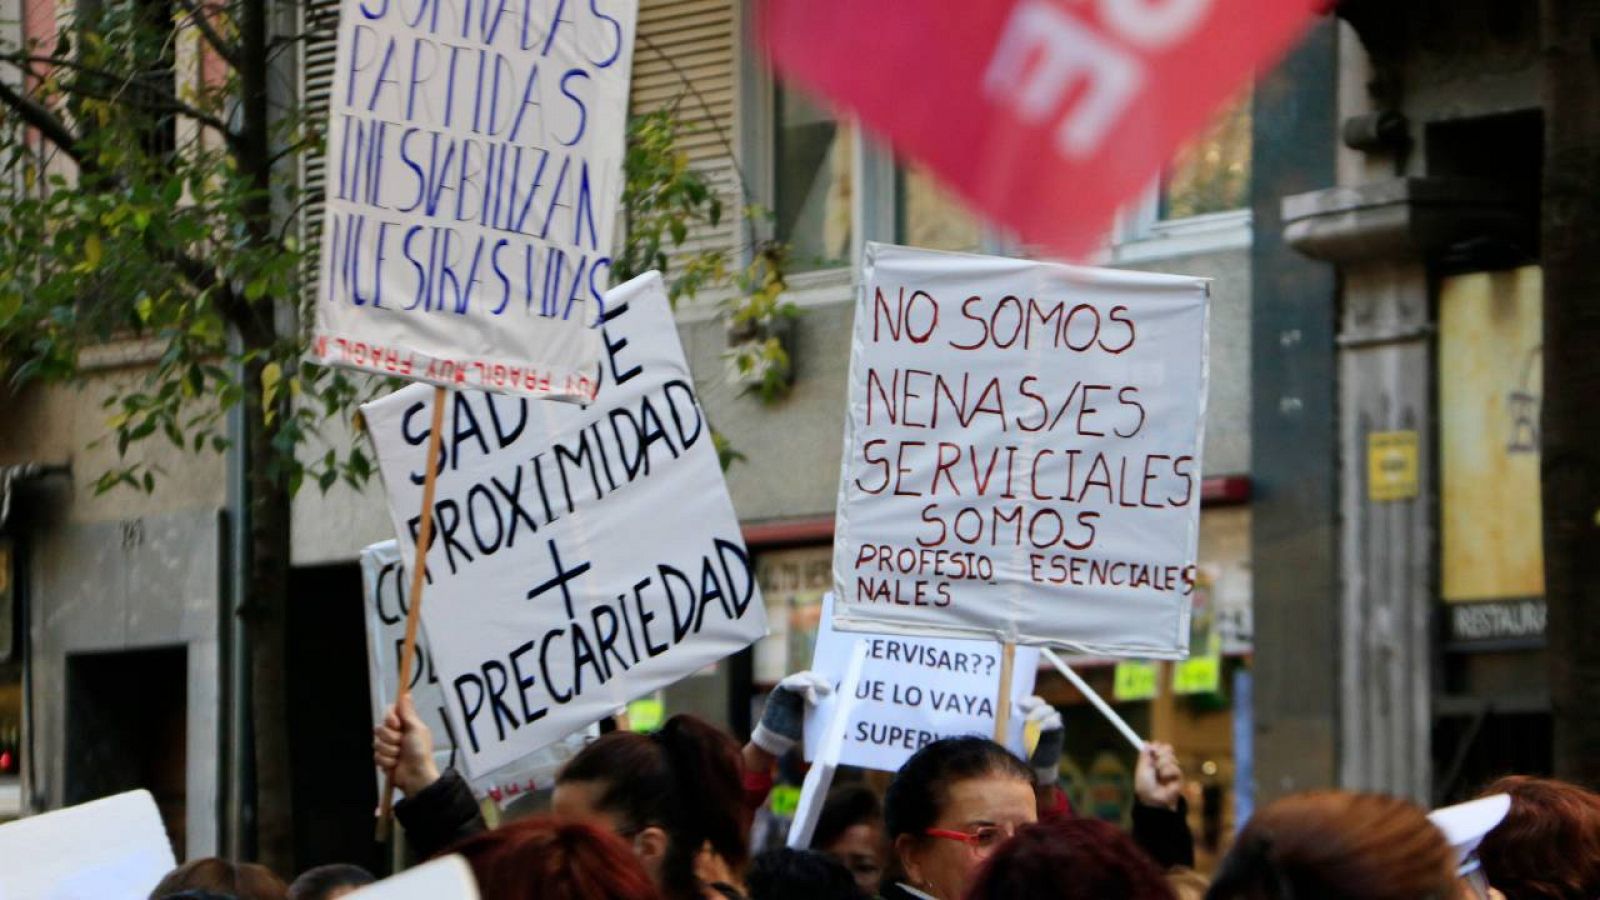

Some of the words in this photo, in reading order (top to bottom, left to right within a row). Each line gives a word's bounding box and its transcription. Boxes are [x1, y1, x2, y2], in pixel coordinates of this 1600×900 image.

[347, 24, 590, 146] PARTIDAS
[335, 113, 598, 251] INESTABILIZAN
[328, 214, 511, 315] NUESTRAS
[526, 243, 612, 329] VIDAS
[873, 286, 939, 343] NO
[949, 295, 1136, 354] SOMOS
[866, 368, 1146, 439] NENAS/ES
[407, 379, 703, 586] PROXIMIDAD
[855, 439, 1194, 508] SERVICIALES
[916, 503, 1101, 550] SOMOS
[857, 576, 952, 608] NALES
[1030, 553, 1196, 596] ESENCIALES
[453, 538, 755, 754] PRECARIEDAD
[834, 679, 885, 702] UE
[893, 683, 923, 706] LO
[930, 688, 995, 720] VAYA
